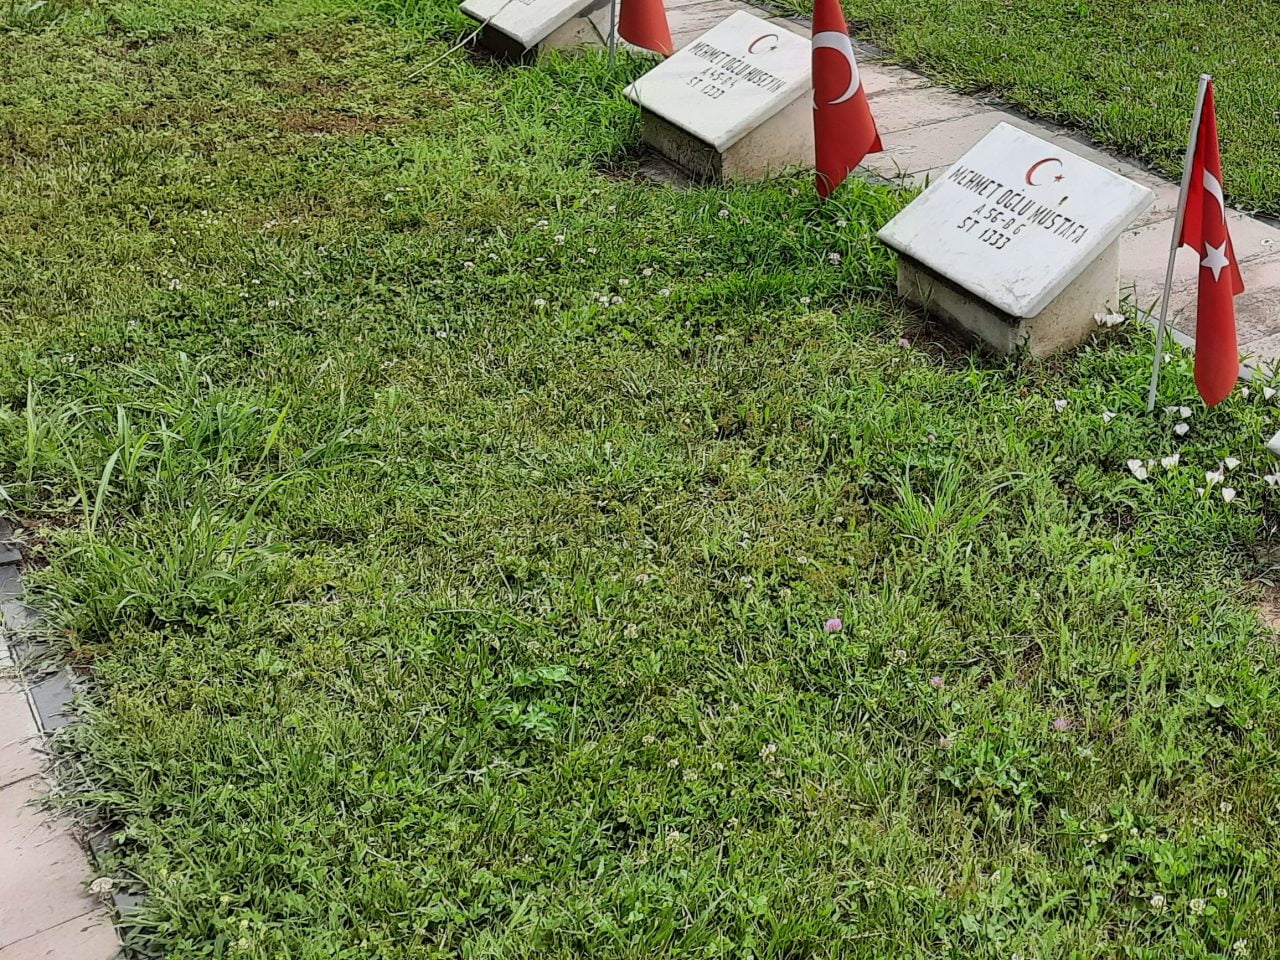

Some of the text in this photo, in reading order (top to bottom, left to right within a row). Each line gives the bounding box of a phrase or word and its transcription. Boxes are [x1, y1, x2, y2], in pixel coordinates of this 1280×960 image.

[688, 41, 731, 66] MEHMET
[721, 55, 752, 76] OĞLU
[948, 165, 1089, 244] MEHMET OĞLU MUSTAFA
[957, 216, 1011, 250] ST 1333
